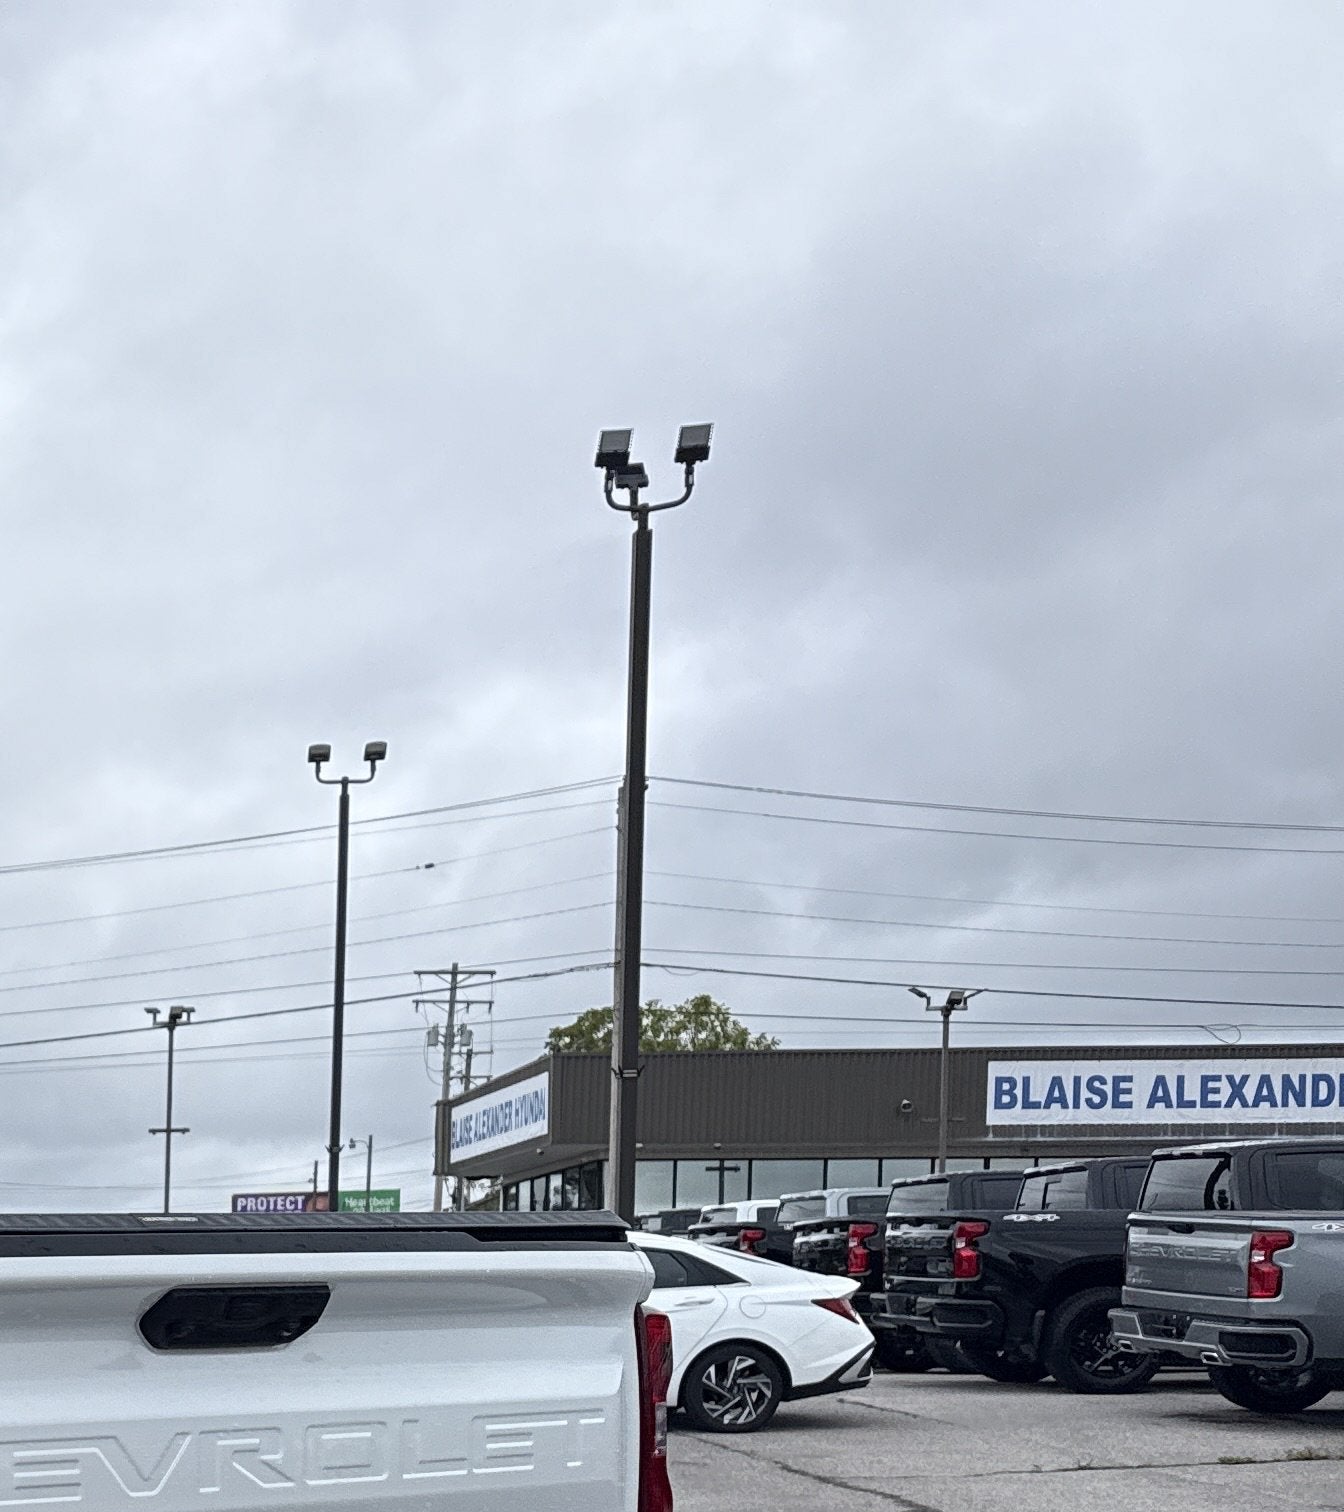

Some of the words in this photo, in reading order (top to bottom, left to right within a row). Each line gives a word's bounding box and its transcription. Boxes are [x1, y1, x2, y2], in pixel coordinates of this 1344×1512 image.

[994, 1075, 1134, 1110] BLAISE
[1146, 1073, 1344, 1109] ALEXAND
[473, 1100, 513, 1143] ALEXANDER
[237, 1195, 306, 1212] PROTECT
